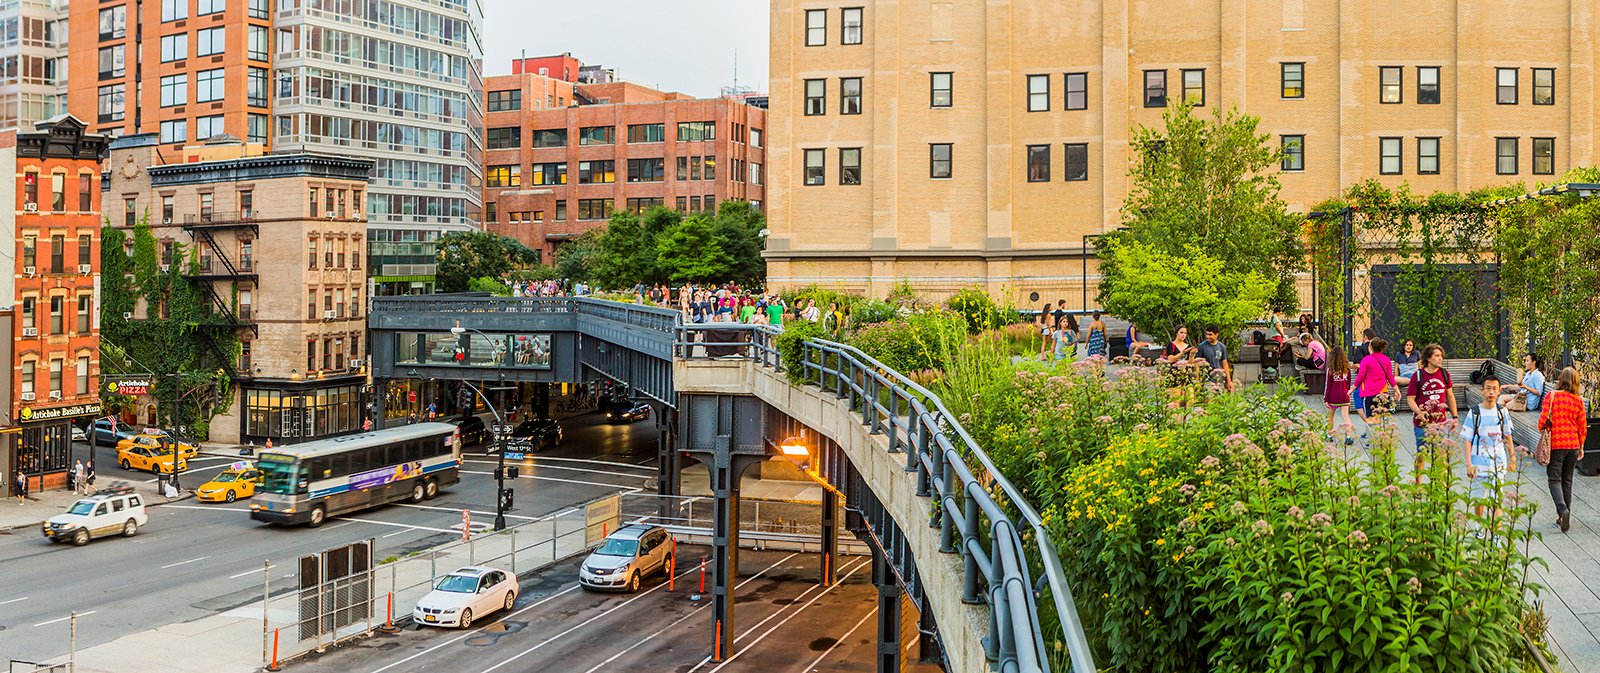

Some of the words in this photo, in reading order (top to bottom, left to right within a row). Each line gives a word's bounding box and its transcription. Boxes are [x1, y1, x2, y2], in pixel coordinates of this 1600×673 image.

[118, 379, 149, 387] Artichoke
[119, 386, 147, 394] PIZZA
[32, 409, 60, 419] Artichoke
[62, 405, 85, 416] Basille's
[85, 404, 100, 413] Pizza
